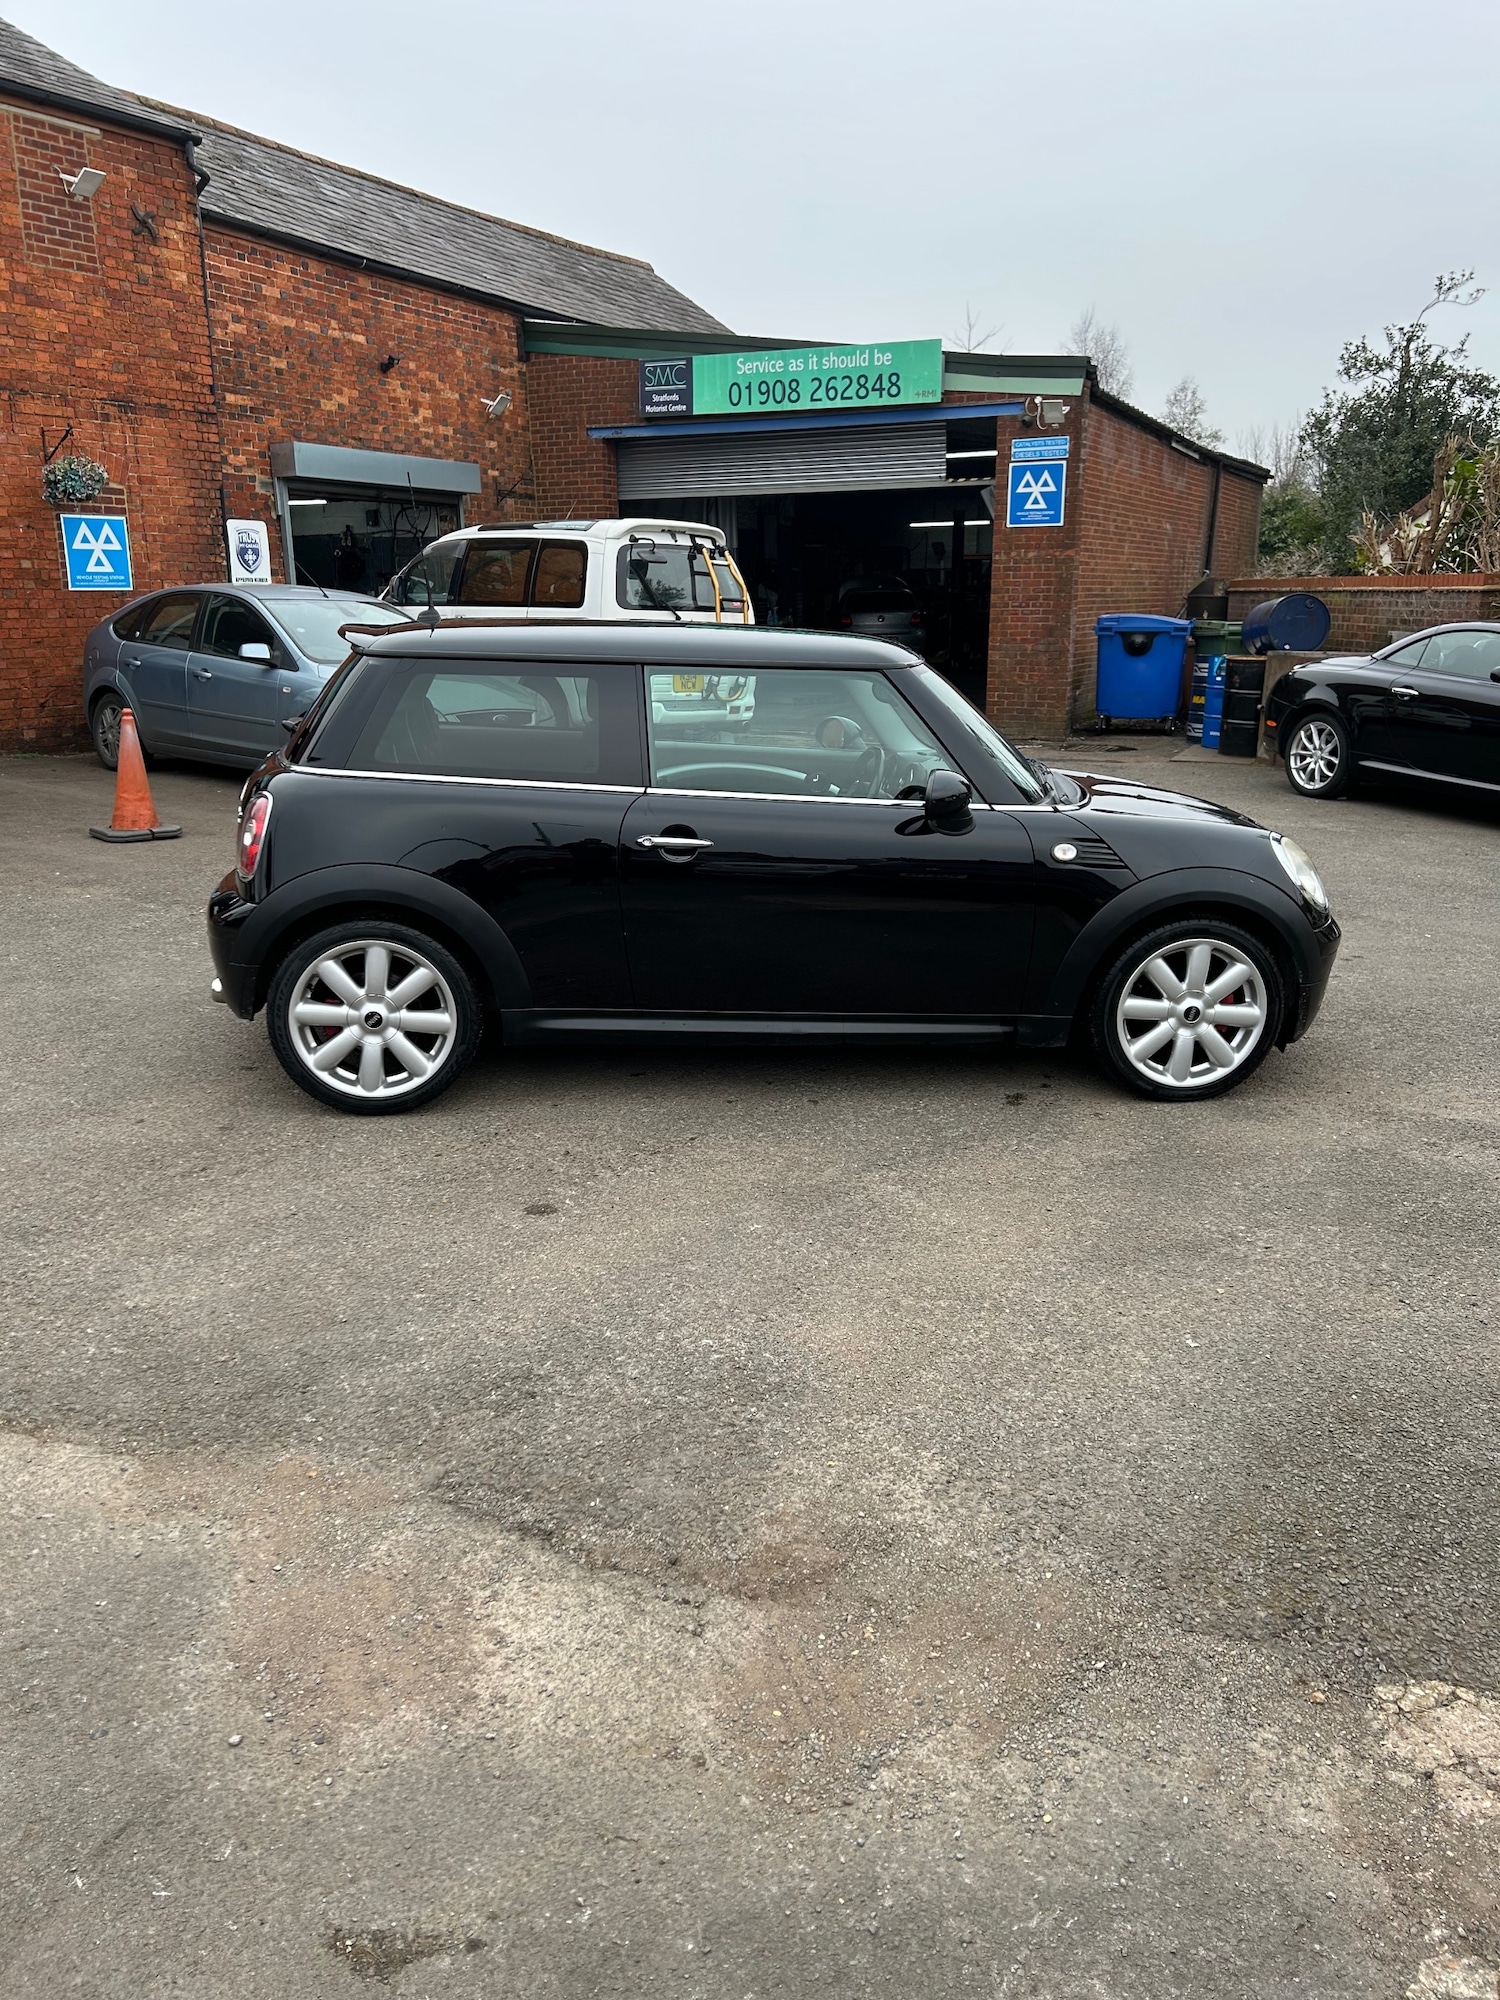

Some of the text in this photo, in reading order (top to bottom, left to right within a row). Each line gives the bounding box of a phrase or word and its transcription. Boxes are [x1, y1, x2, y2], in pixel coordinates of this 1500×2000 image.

[736, 349, 892, 375] Service as it should be
[645, 365, 686, 386] SMC
[728, 372, 901, 407] 01908 262848
[645, 404, 687, 413] Motorist Centre
[1015, 440, 1044, 448] CATALYSTS
[1014, 449, 1065, 458] DIESELS TESTED
